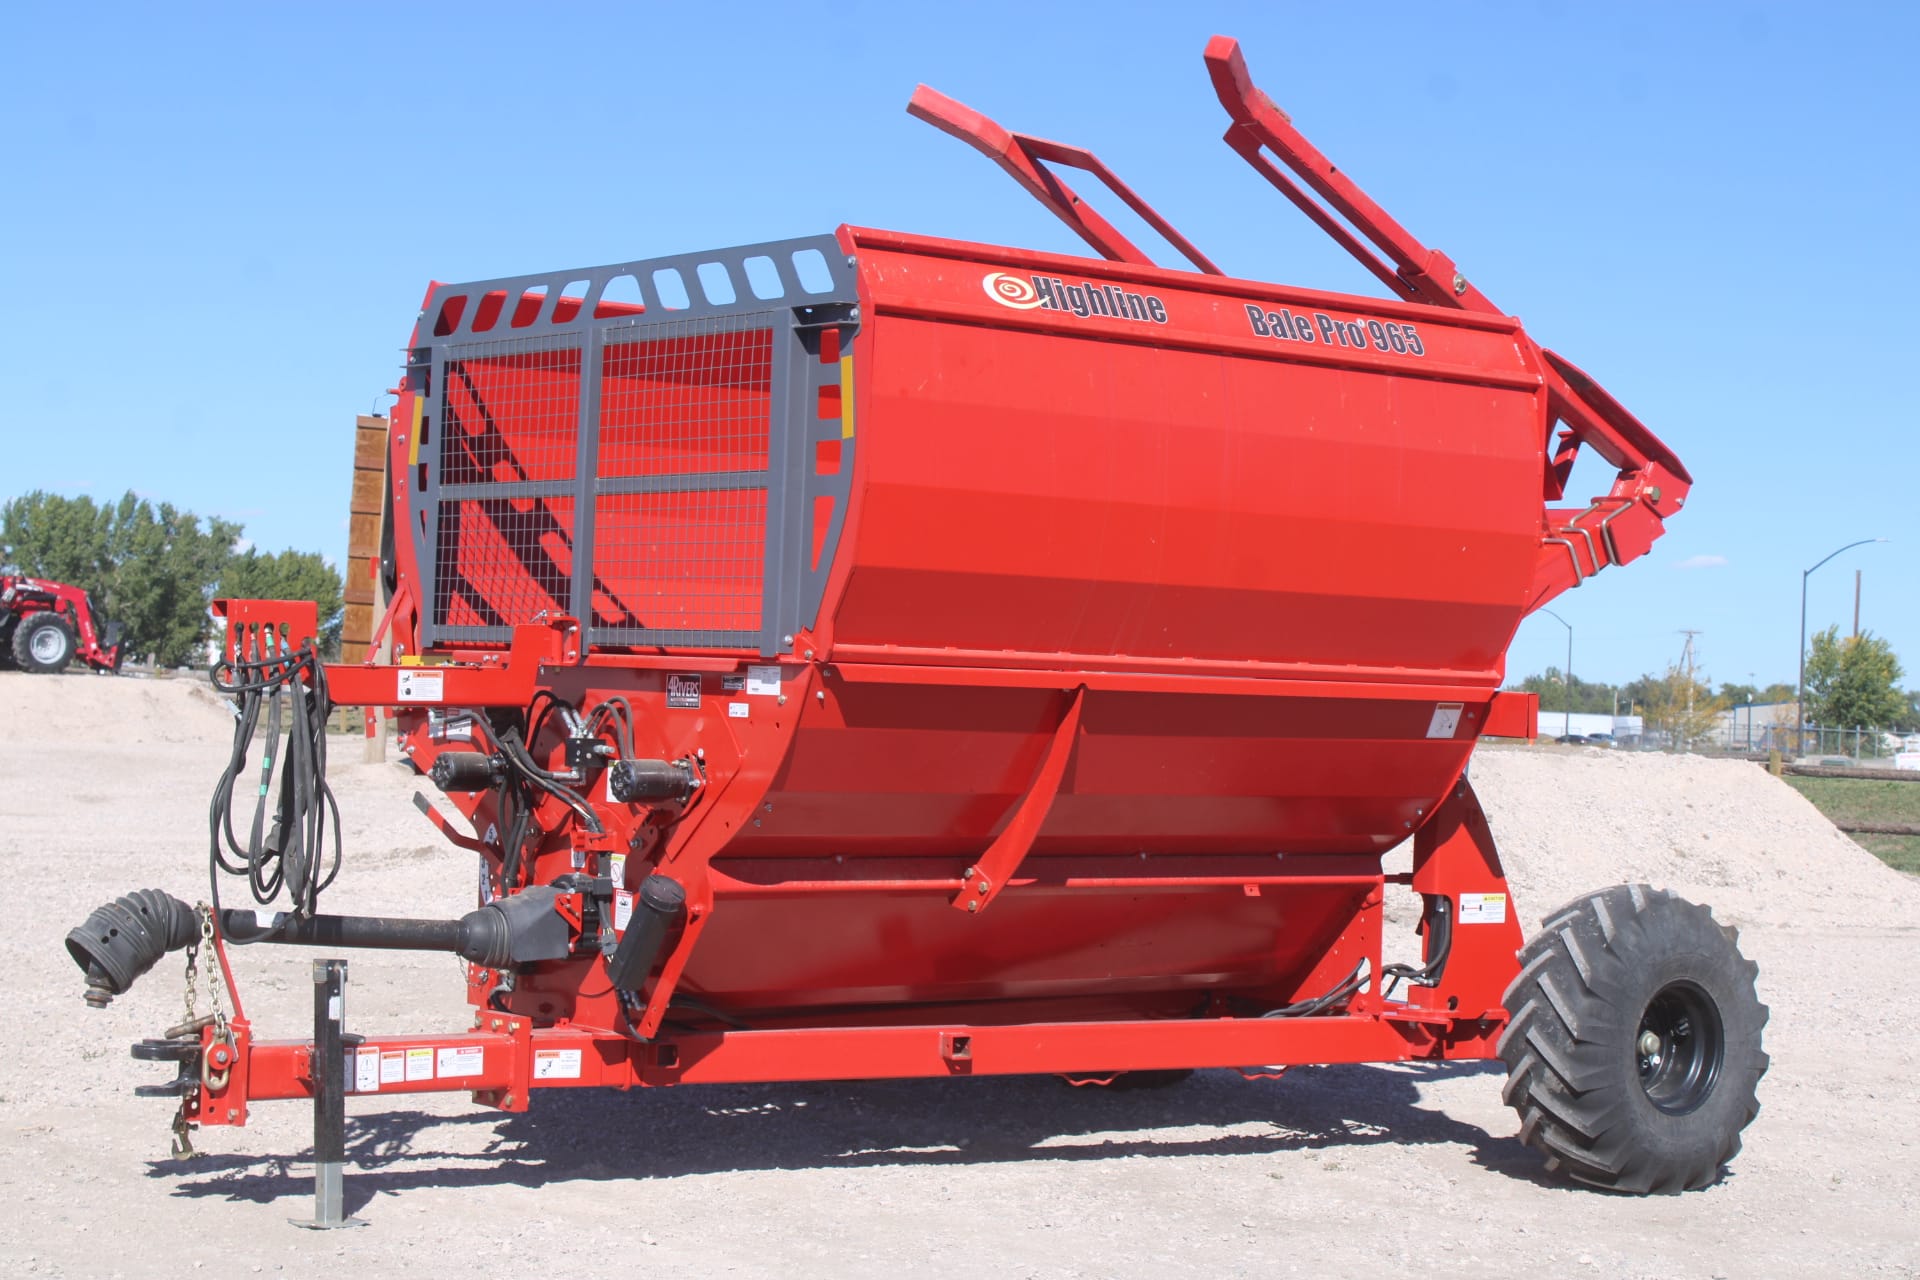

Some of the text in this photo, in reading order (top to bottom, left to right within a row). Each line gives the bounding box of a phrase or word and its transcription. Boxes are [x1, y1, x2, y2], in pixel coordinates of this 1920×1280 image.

[1031, 275, 1168, 324] Highline
[1244, 304, 1315, 342] Bale
[1367, 319, 1425, 357] 965
